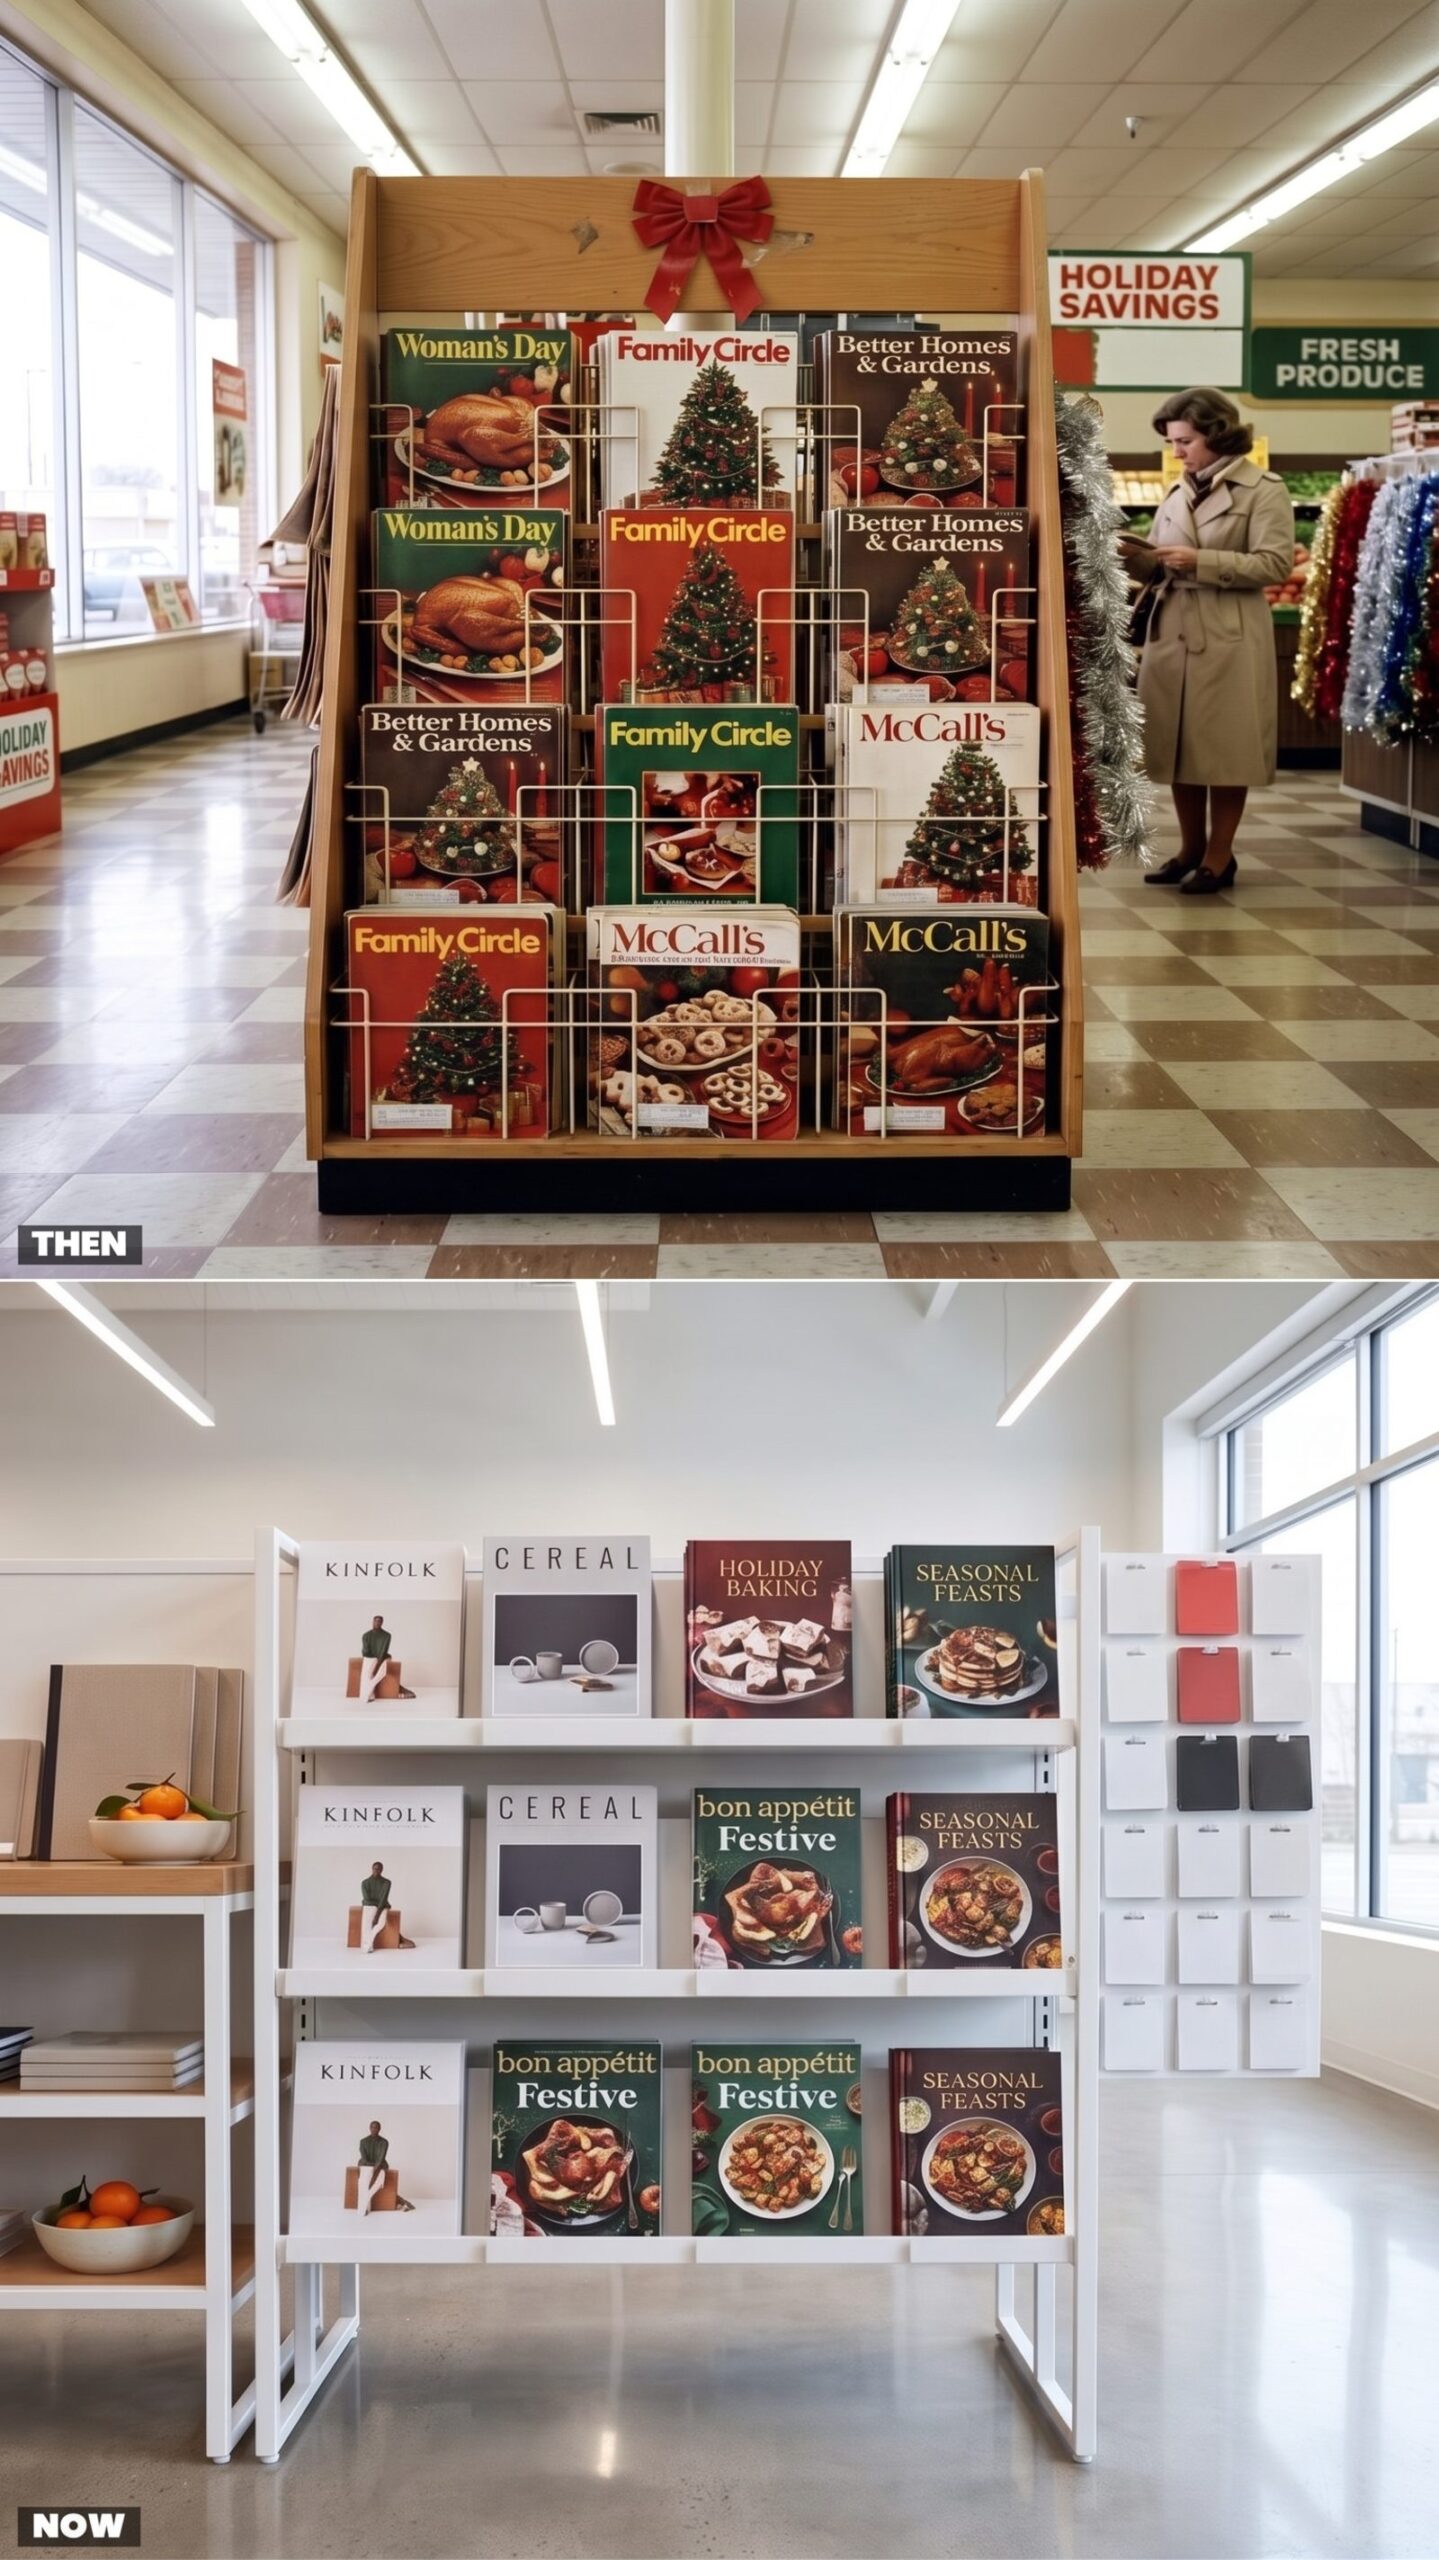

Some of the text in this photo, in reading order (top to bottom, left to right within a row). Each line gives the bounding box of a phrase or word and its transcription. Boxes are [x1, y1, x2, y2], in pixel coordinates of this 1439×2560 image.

[1060, 264, 1219, 290] HOLIDAY
[1060, 293, 1219, 320] SAVINGS
[395, 333, 567, 364] Woman's Day
[617, 336, 791, 367] Family Circle
[837, 336, 1011, 355] Better Homes
[1301, 338, 1400, 362] FRESH
[856, 356, 878, 374] &
[1276, 364, 1424, 388] PRODUCE
[383, 513, 556, 546] Woman's Day
[610, 517, 787, 549] Family Circle
[846, 513, 1023, 533] Better Homes
[865, 534, 1004, 552] & Gardens
[371, 712, 552, 732] Better Homes
[860, 713, 1006, 742] McCall's
[0, 720, 47, 757] OLIDAY
[392, 733, 532, 752] & Gardens
[610, 721, 792, 753] Family Circle
[0, 748, 49, 788] AVINGS
[355, 927, 541, 960] Family Circle
[611, 923, 766, 955] McCall's
[864, 920, 1028, 953] McCall's
[325, 1562, 437, 1577] KINFOLK
[495, 1547, 640, 1570] CEREAL
[719, 1560, 824, 1577] HOLIDAY
[916, 1564, 1040, 1582] SEASONAL
[726, 1580, 818, 1597] BAKING
[934, 1584, 1023, 1602] FEASTS
[324, 1807, 436, 1822] KINFOLK
[499, 1796, 643, 1820] CEREAL
[697, 1795, 857, 1824] bon appétit
[919, 1812, 1040, 1829] SEASONAL
[717, 1826, 838, 1851] Festive
[938, 1832, 1023, 1849] FEASTS
[321, 2065, 434, 2080] KINFOLK
[498, 2051, 657, 2080] bon appétit
[697, 2051, 857, 2081] bon appétit
[923, 2072, 1044, 2090] SEASONAL
[517, 2082, 638, 2109] Festive
[717, 2083, 838, 2109] Festive
[940, 2092, 1027, 2110] FEASTS
